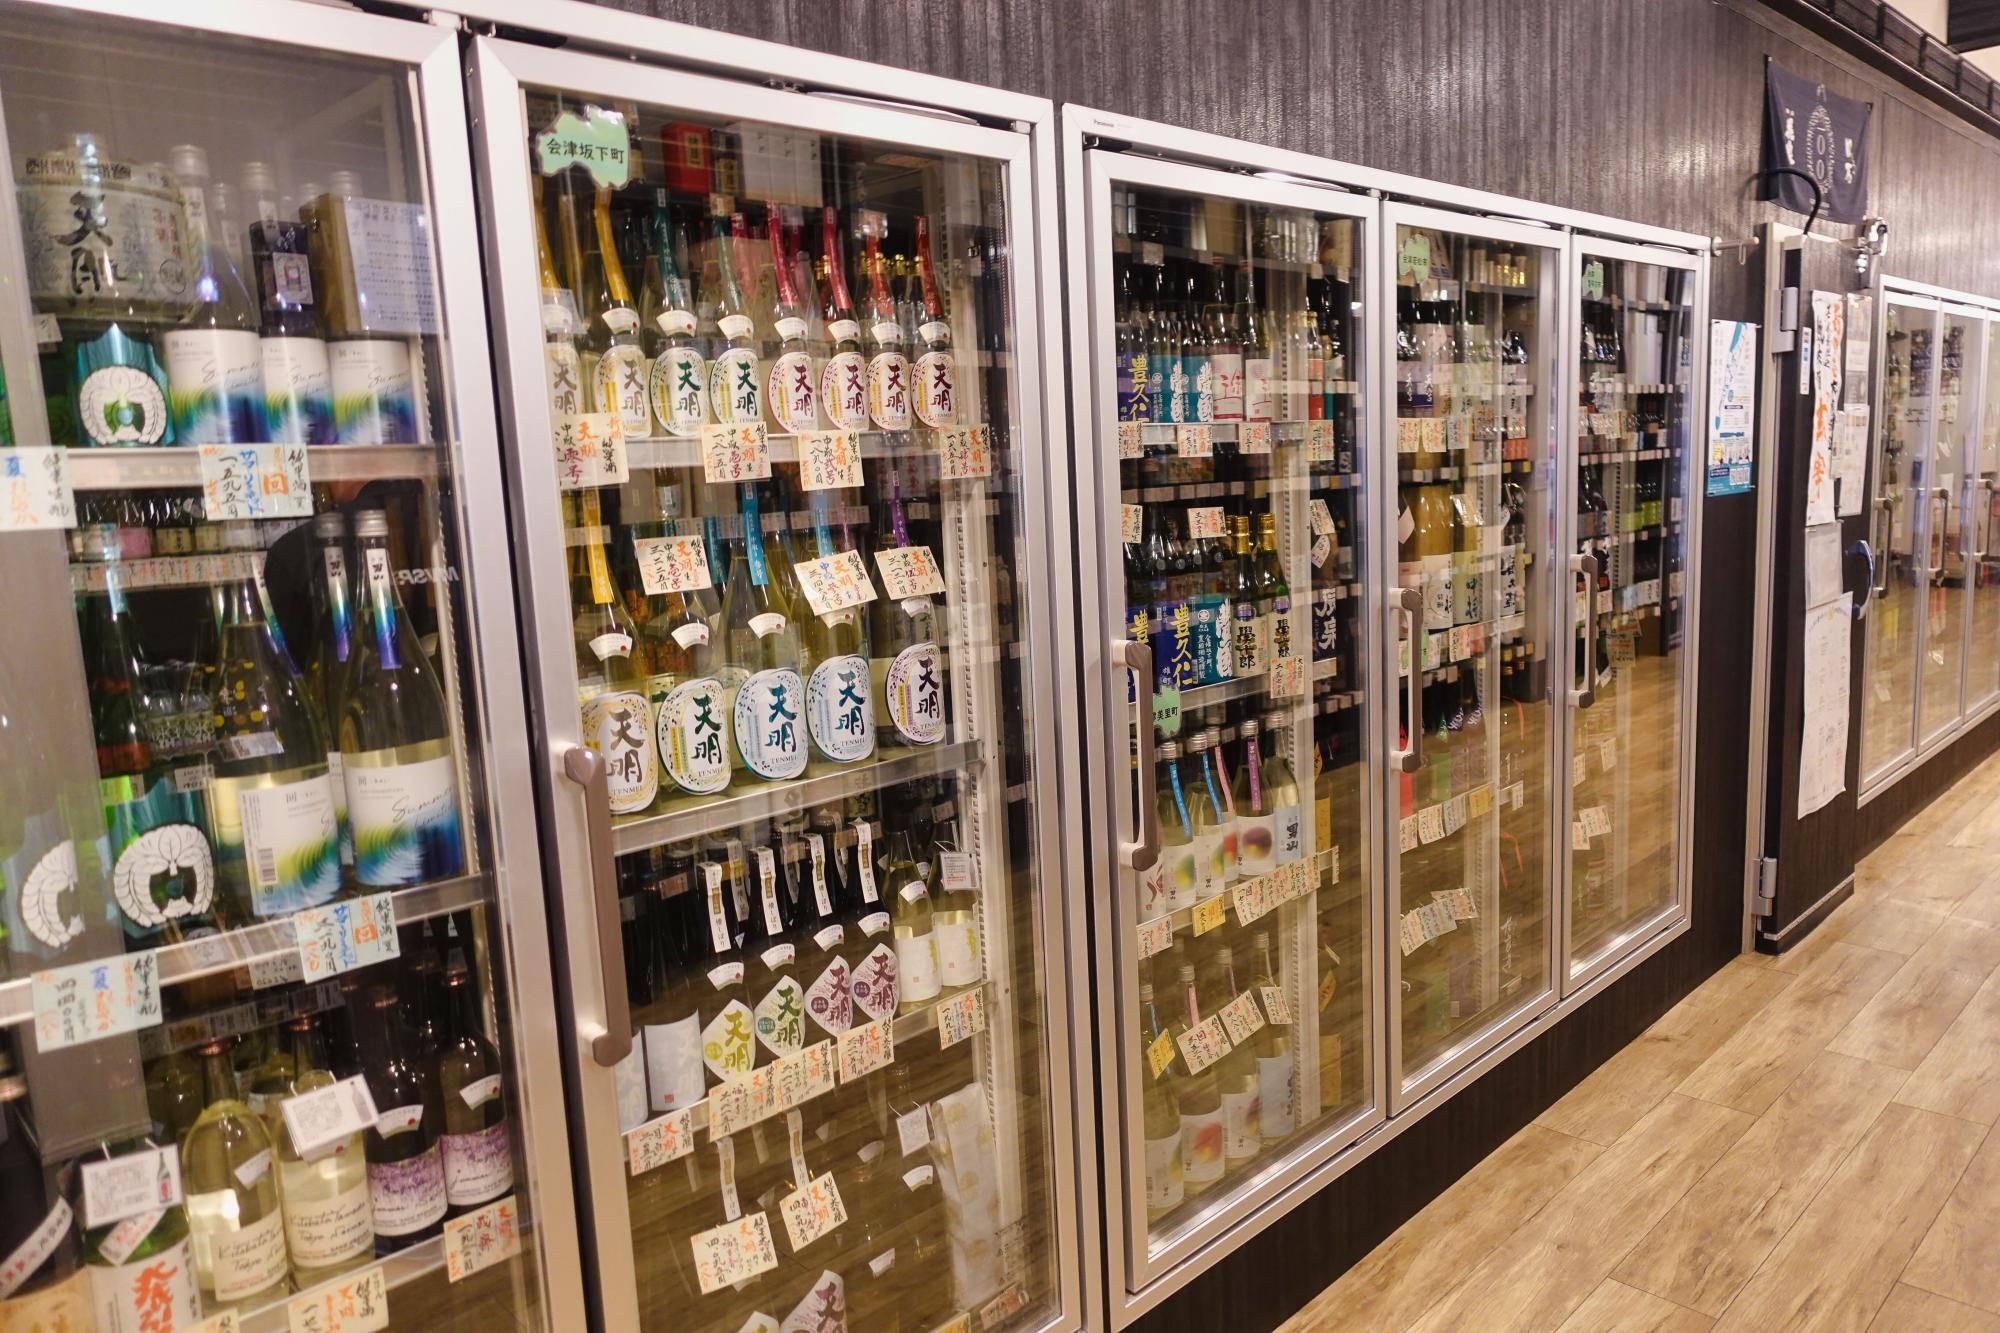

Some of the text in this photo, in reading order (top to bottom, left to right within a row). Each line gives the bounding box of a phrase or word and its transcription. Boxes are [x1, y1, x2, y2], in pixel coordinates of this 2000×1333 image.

[546, 138, 625, 165] 会津坂下町
[553, 359, 577, 415] 天明
[621, 359, 646, 418] 天明
[676, 360, 702, 418] 天明
[735, 361, 758, 416] 天明
[793, 363, 814, 419] 天明
[846, 363, 865, 416] 天明
[886, 363, 907, 416] 天明
[930, 362, 952, 412] 天明
[1169, 601, 1194, 688] 豊久仁
[834, 669, 868, 736] 天明
[914, 655, 941, 719] 天明
[607, 706, 646, 784] 天明
[691, 693, 724, 765] 天明
[764, 682, 799, 753] 天明
[866, 951, 898, 1013] 天明
[720, 1008, 752, 1073] 天明
[774, 984, 802, 1048] 天明
